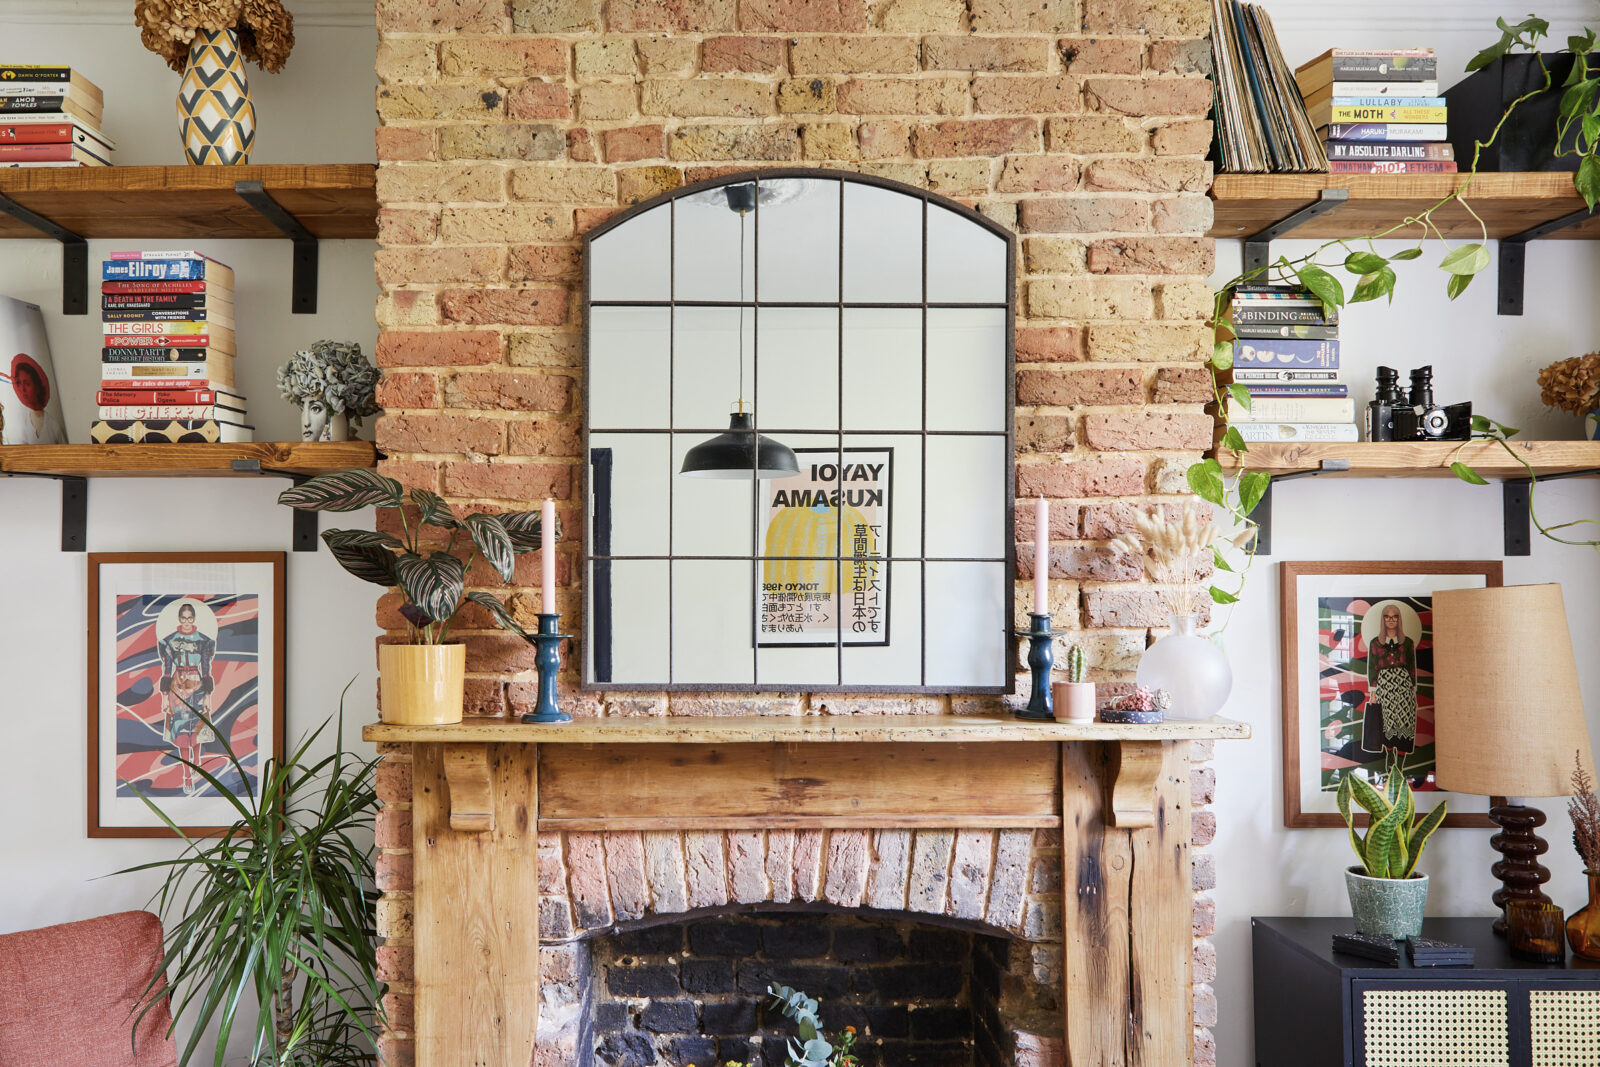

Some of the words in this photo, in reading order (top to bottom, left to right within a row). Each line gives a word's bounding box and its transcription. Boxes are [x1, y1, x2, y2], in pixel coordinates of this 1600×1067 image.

[1354, 110, 1384, 119] MOTH
[1334, 145, 1347, 157] MY
[1349, 145, 1389, 157] ABSOLUTE
[1391, 146, 1425, 157] DARLING
[1334, 162, 1372, 172] JONATHAN
[1405, 163, 1443, 172] LETHEM
[106, 265, 128, 274] James
[128, 262, 167, 279] Ellroy
[1247, 312, 1298, 320] BINDING
[108, 323, 128, 333] THE
[131, 323, 163, 333] GIRLS
[114, 337, 153, 346] POWER
[134, 407, 209, 420] CHERRY
[1241, 431, 1273, 440] ARTIN
